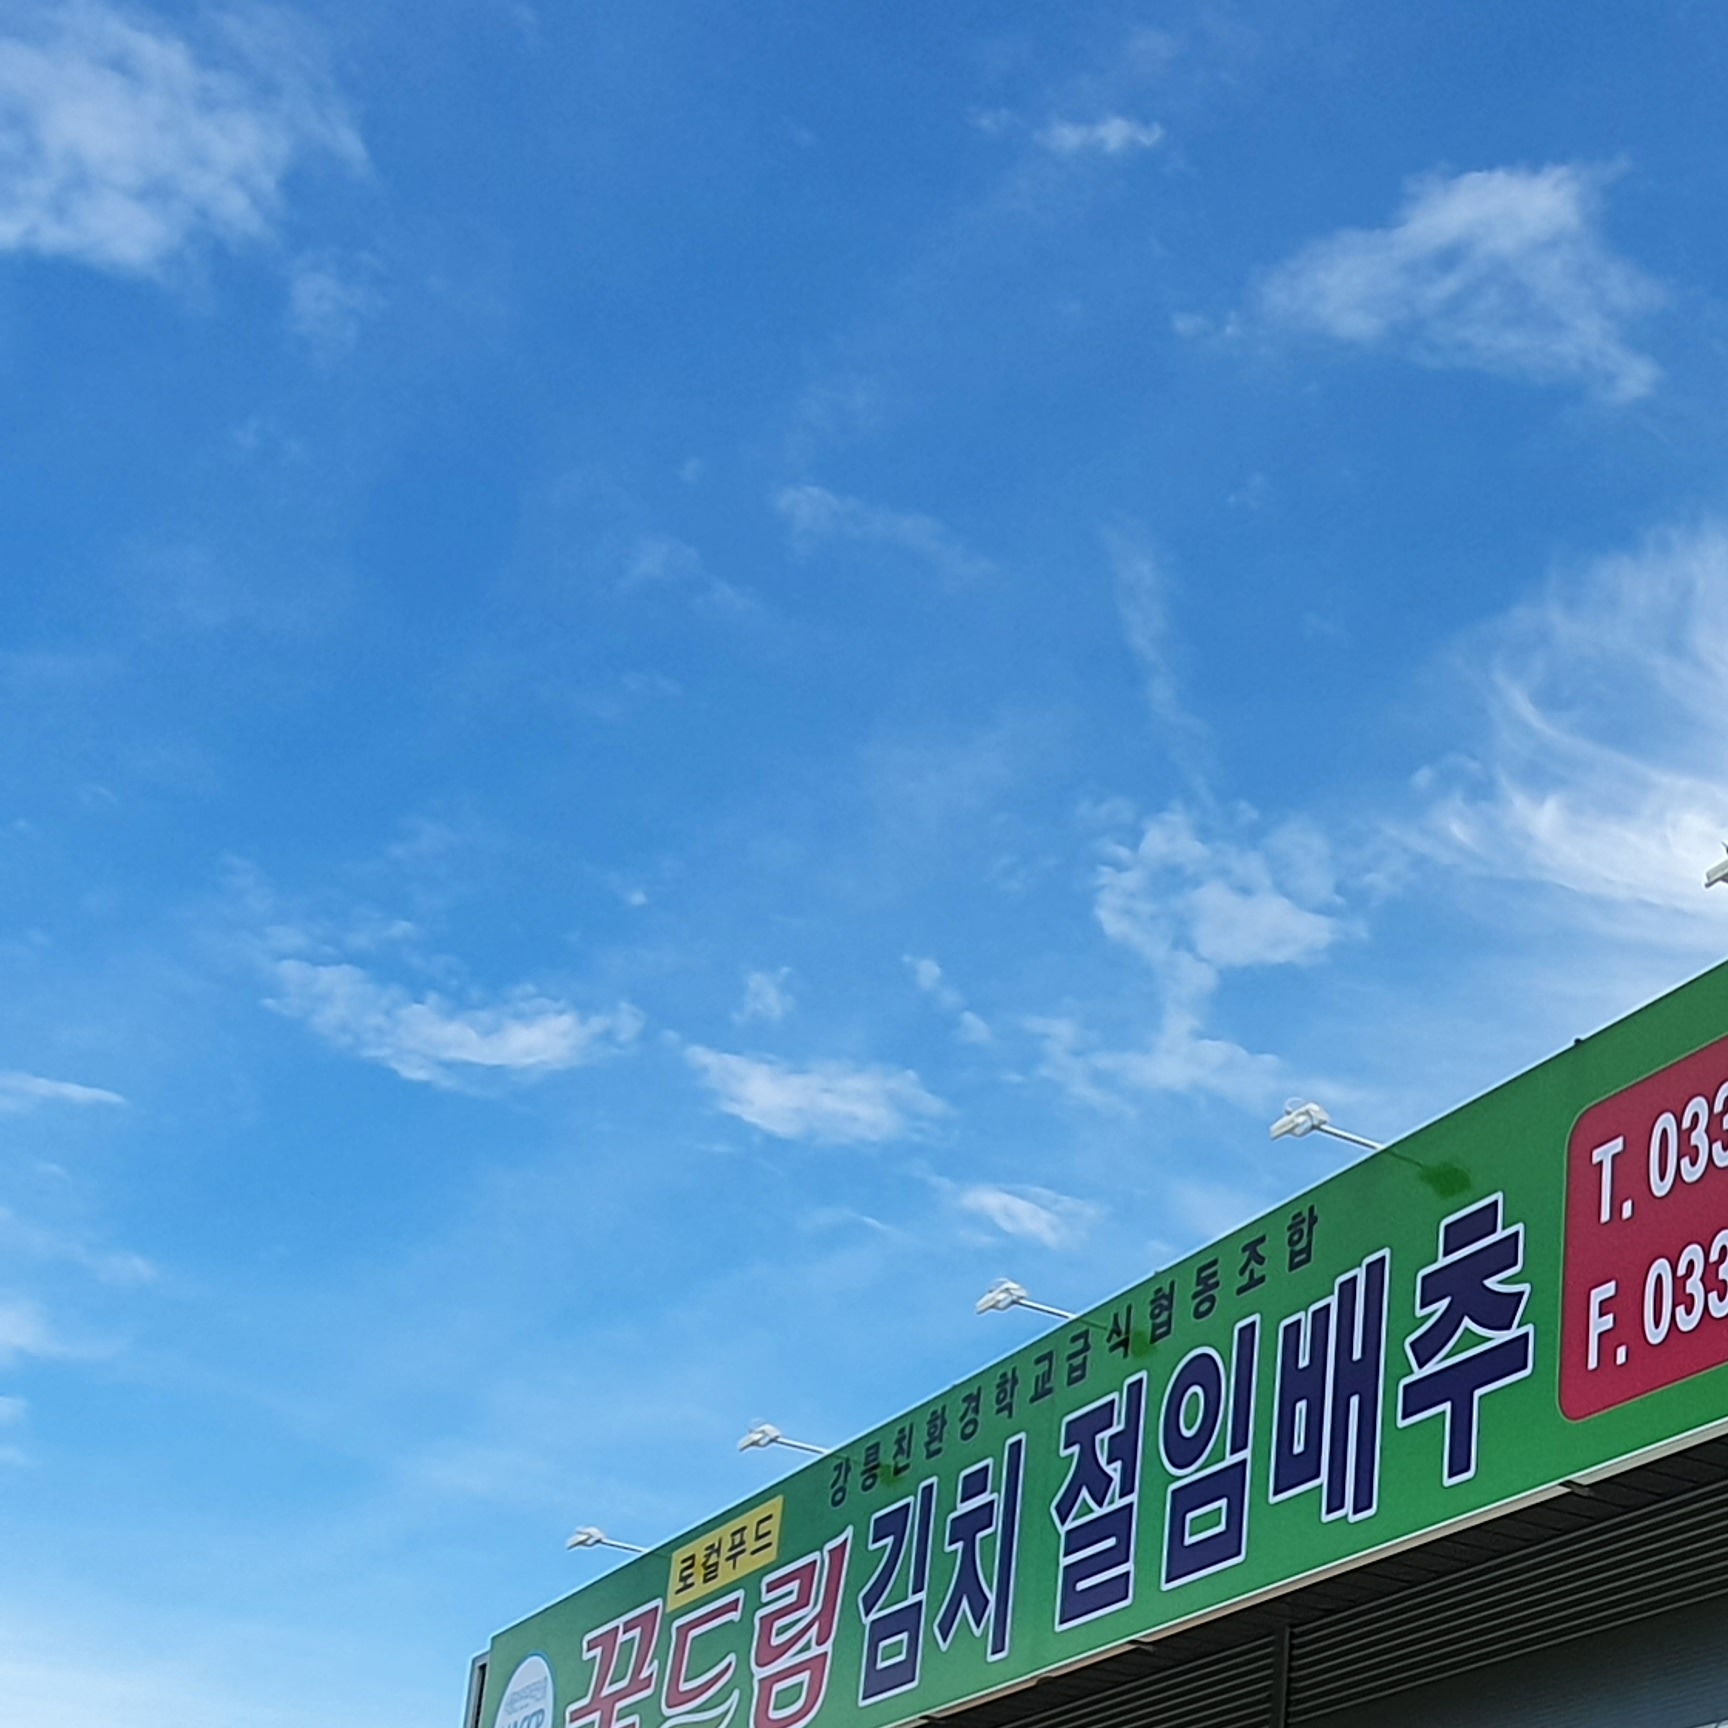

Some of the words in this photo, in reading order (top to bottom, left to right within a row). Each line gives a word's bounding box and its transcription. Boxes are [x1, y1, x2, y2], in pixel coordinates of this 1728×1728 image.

[1591, 1136, 1633, 1224] T.
[1586, 1280, 1628, 1371] F.
[675, 1513, 774, 1595] 로컬푸드
